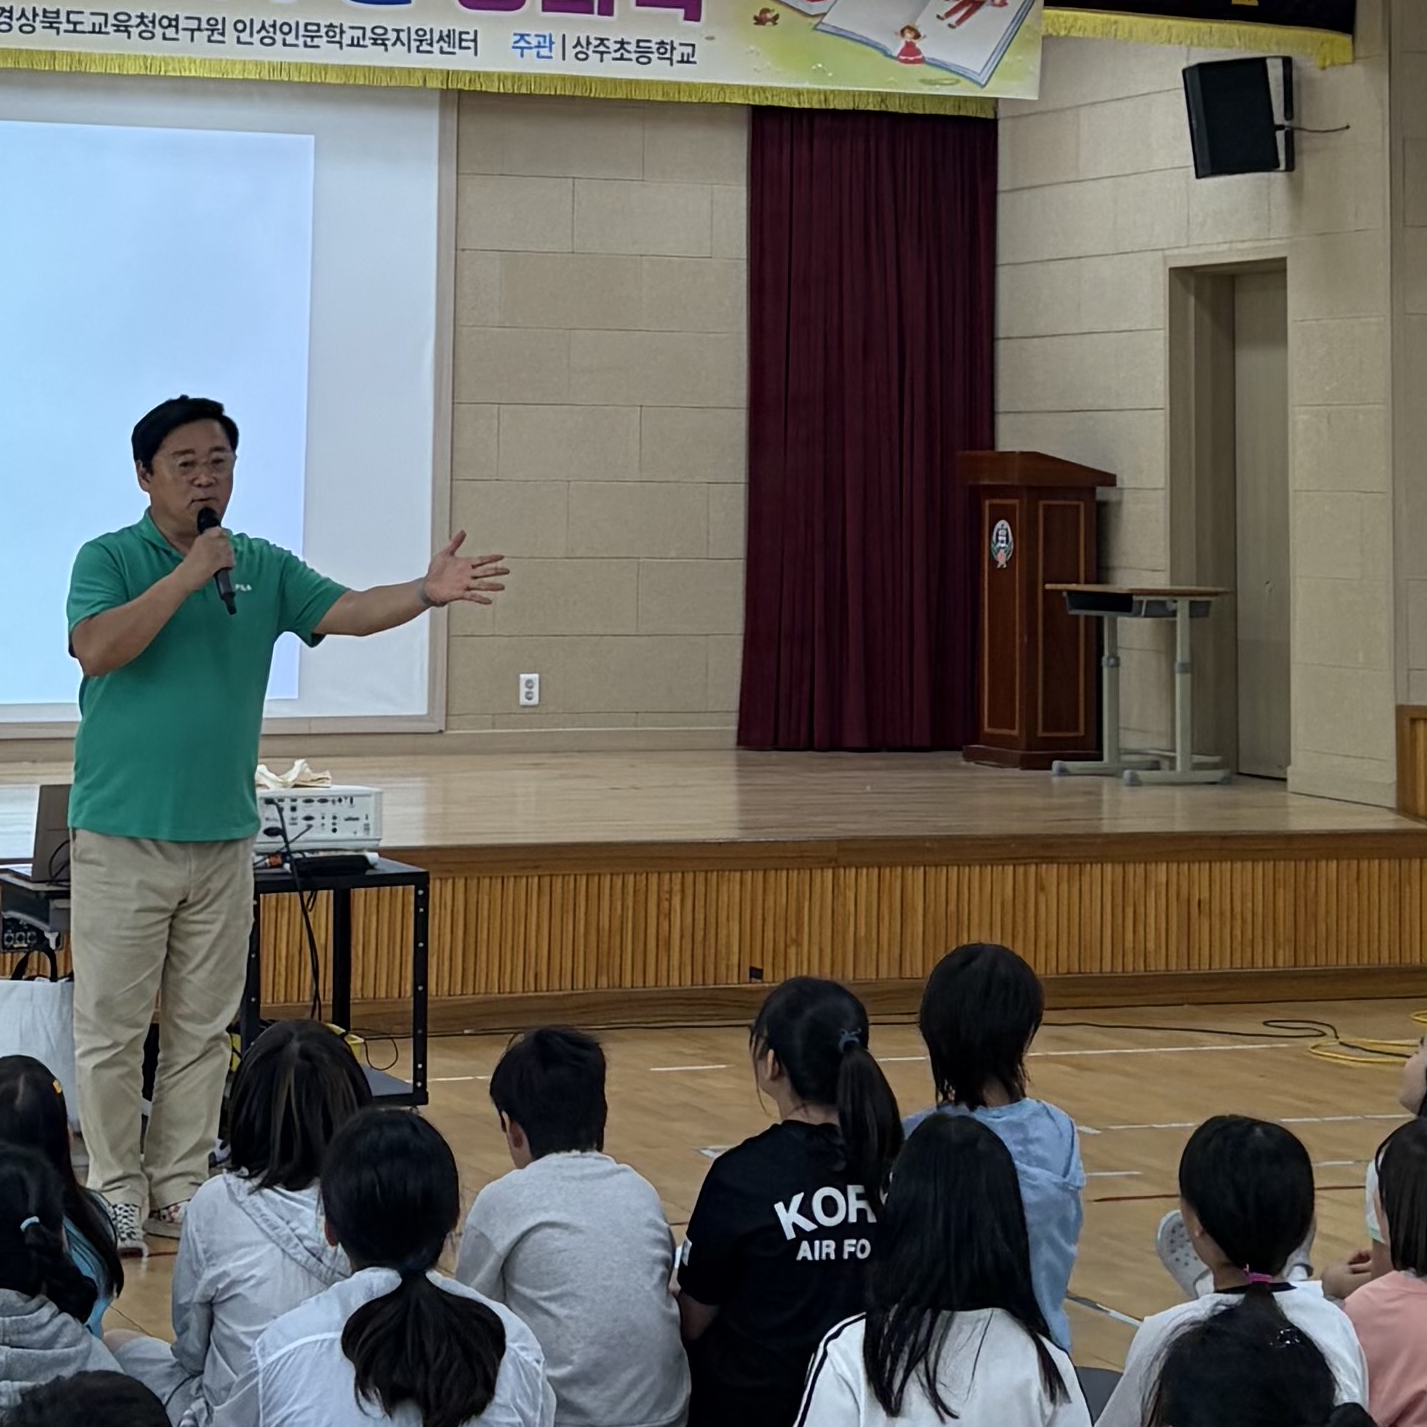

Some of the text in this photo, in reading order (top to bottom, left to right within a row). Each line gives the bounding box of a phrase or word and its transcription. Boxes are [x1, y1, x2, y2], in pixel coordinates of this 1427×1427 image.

[234, 20, 480, 58] 인성인문학교육지원센터
[510, 29, 698, 68] 주관 상주초등학교
[796, 1238, 871, 1261] AIR FO
